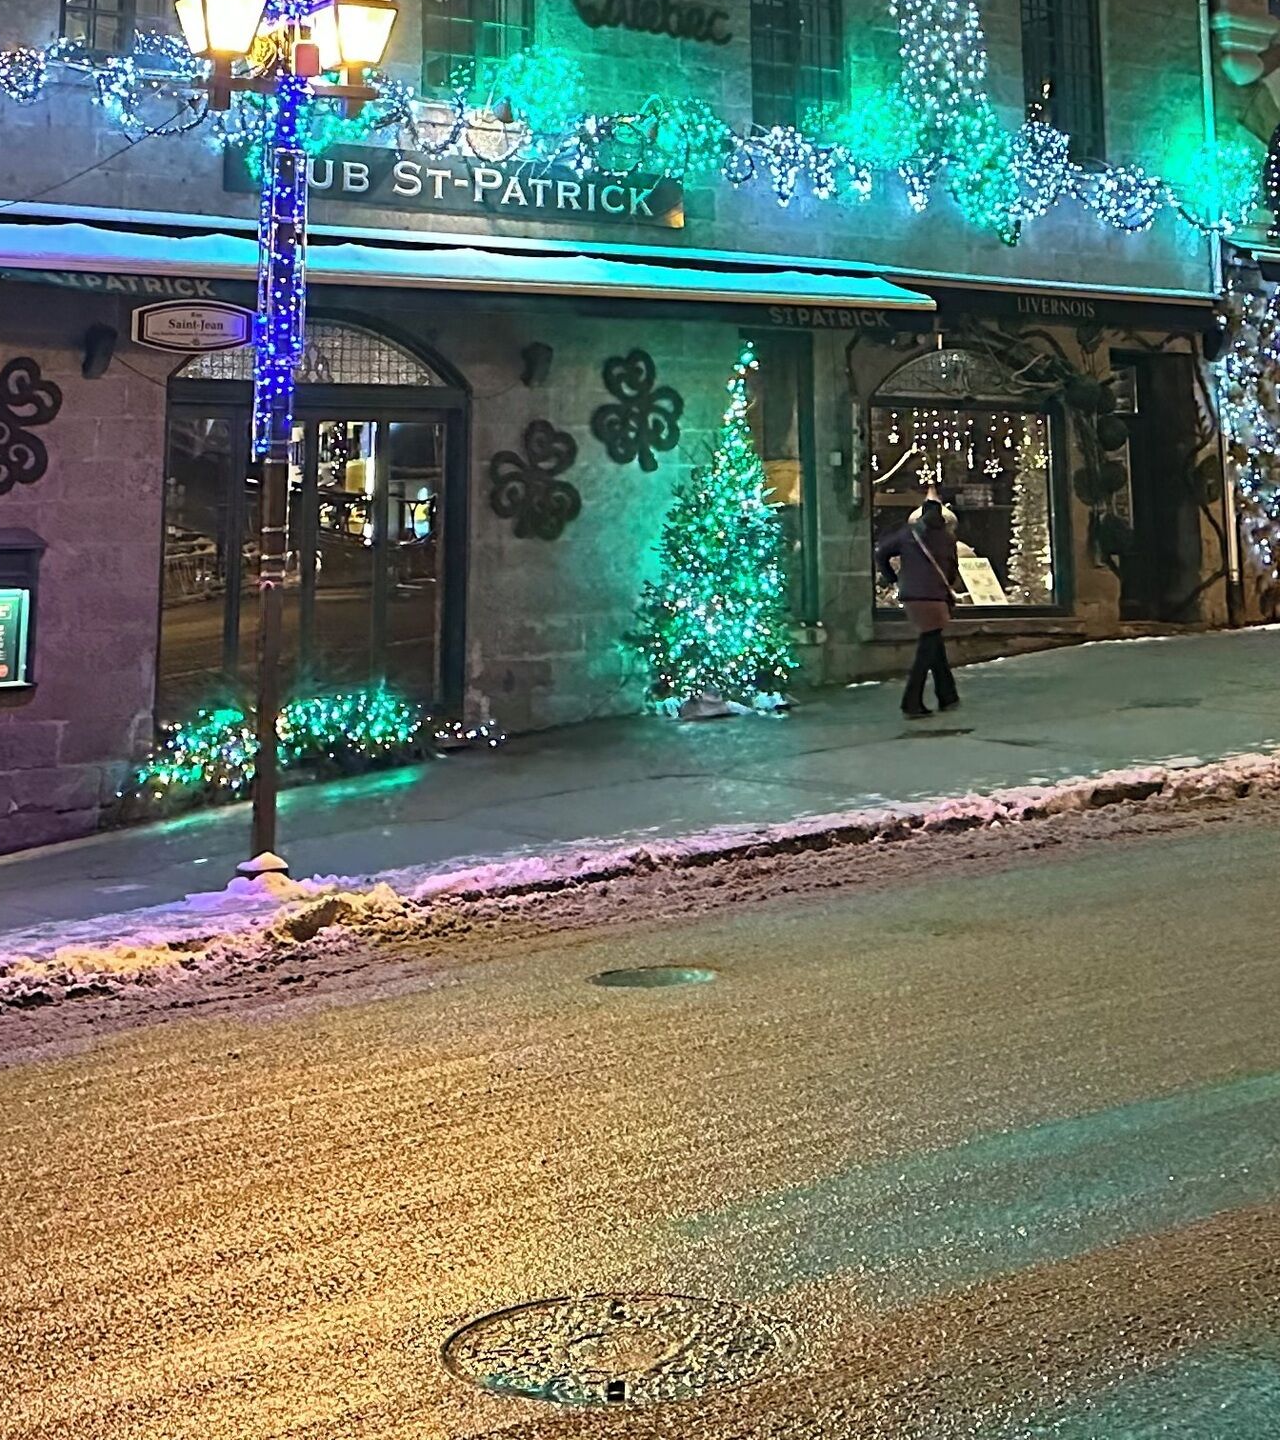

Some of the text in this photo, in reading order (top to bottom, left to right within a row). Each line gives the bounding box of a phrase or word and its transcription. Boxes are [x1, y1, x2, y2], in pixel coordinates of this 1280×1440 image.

[306, 159, 654, 217] UB ST-PATRICK
[796, 308, 891, 327] PATRICK
[1016, 296, 1096, 319] LIVERNOIS
[168, 318, 224, 332] Saint-Jean
